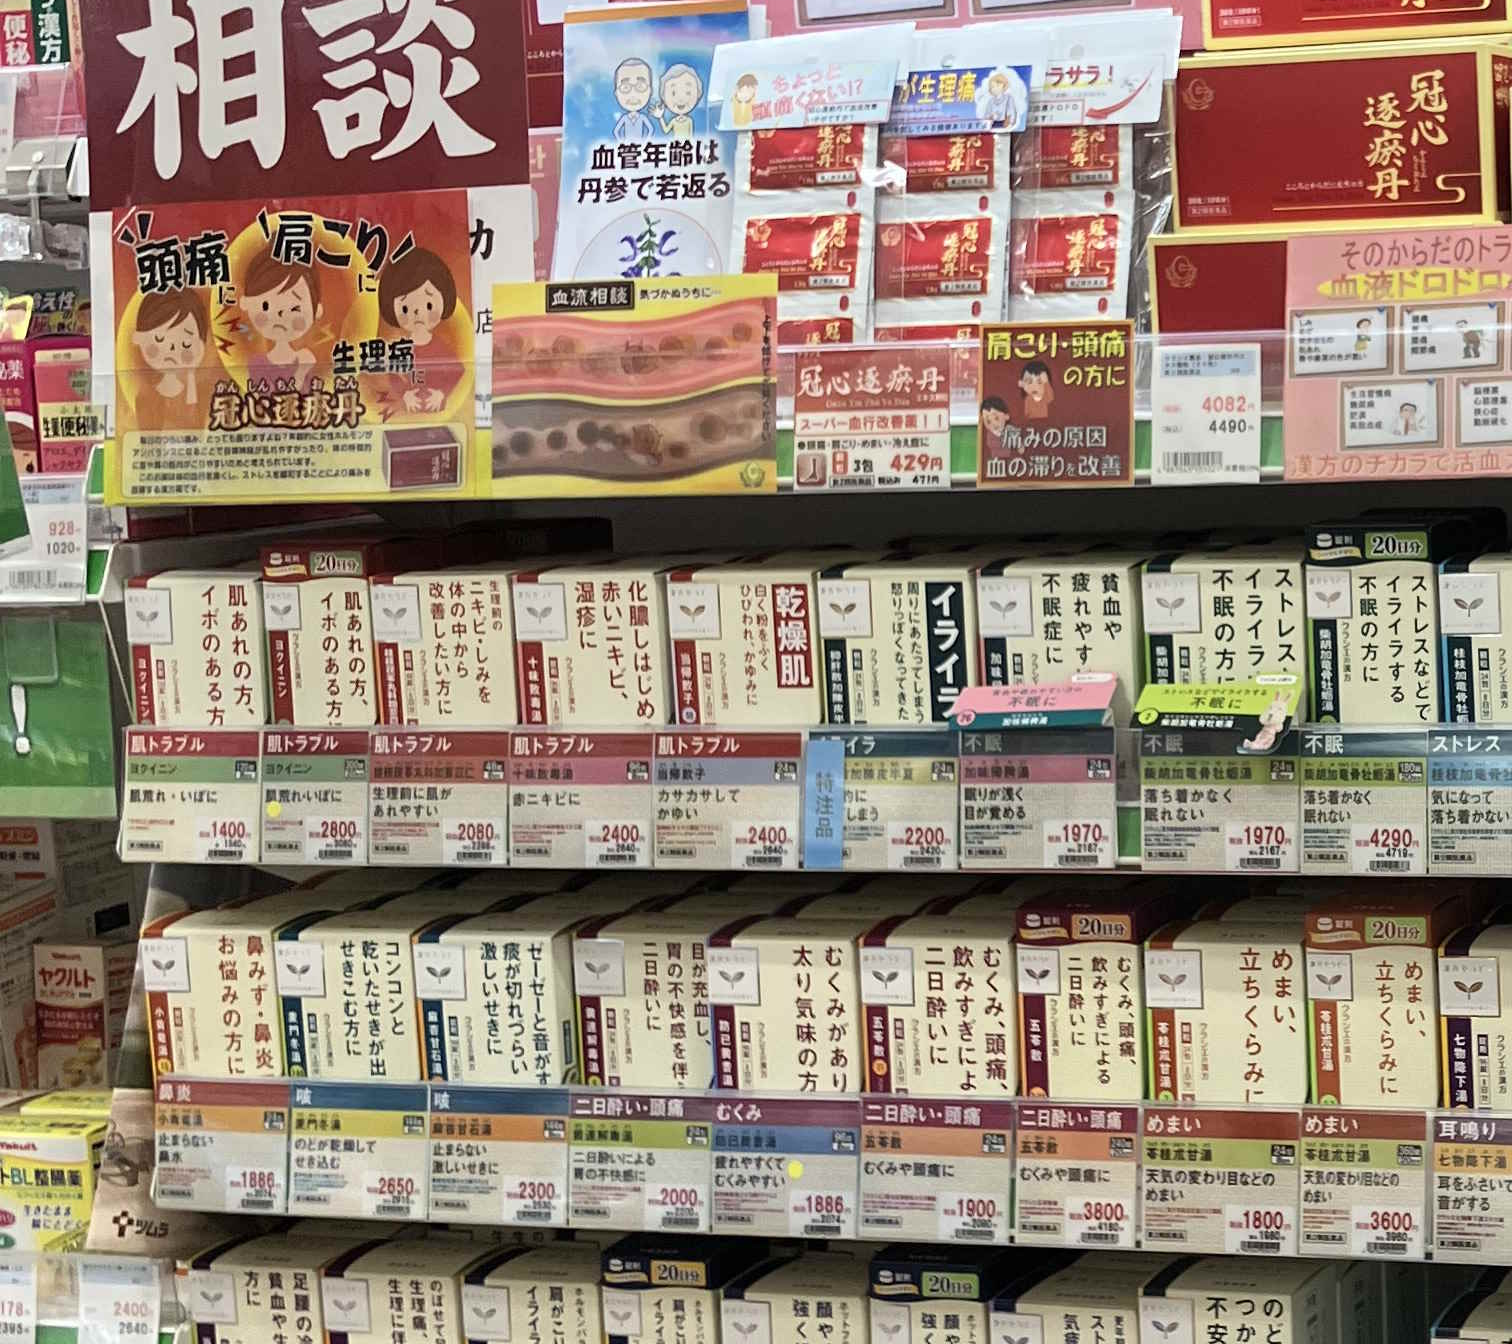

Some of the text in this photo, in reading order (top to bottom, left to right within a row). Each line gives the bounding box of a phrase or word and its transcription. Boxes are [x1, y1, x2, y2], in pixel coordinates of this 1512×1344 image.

[591, 139, 719, 171] 血管年齢は
[577, 172, 732, 205] 丹参で若返る
[552, 287, 629, 309] 血流相談
[1064, 363, 1125, 387] の方に
[1002, 426, 1106, 450] 痛みの原因
[890, 453, 943, 473] 429円
[986, 456, 1121, 478] 血の滞りを改善
[576, 581, 597, 649] 湿疹に
[1041, 574, 1064, 665] 不眠症に
[1102, 574, 1122, 640] 貧血や
[449, 581, 469, 678] 体の中から
[775, 585, 811, 687] 乾燥肌
[1386, 576, 1406, 704] イライラする
[130, 735, 205, 753] 肌トラブル
[1304, 733, 1344, 753] 不眠
[1432, 733, 1501, 754] ストレス
[218, 935, 245, 1075] お悩みの方に
[927, 947, 948, 1065] 二日酔いに
[1092, 957, 1110, 1084] 飲みすぎによる
[1376, 961, 1398, 1095] 立ちくらみに
[716, 1104, 761, 1121] むくみ
[1146, 1116, 1201, 1134] めまい
[1439, 1120, 1497, 1141] 耳鳴り
